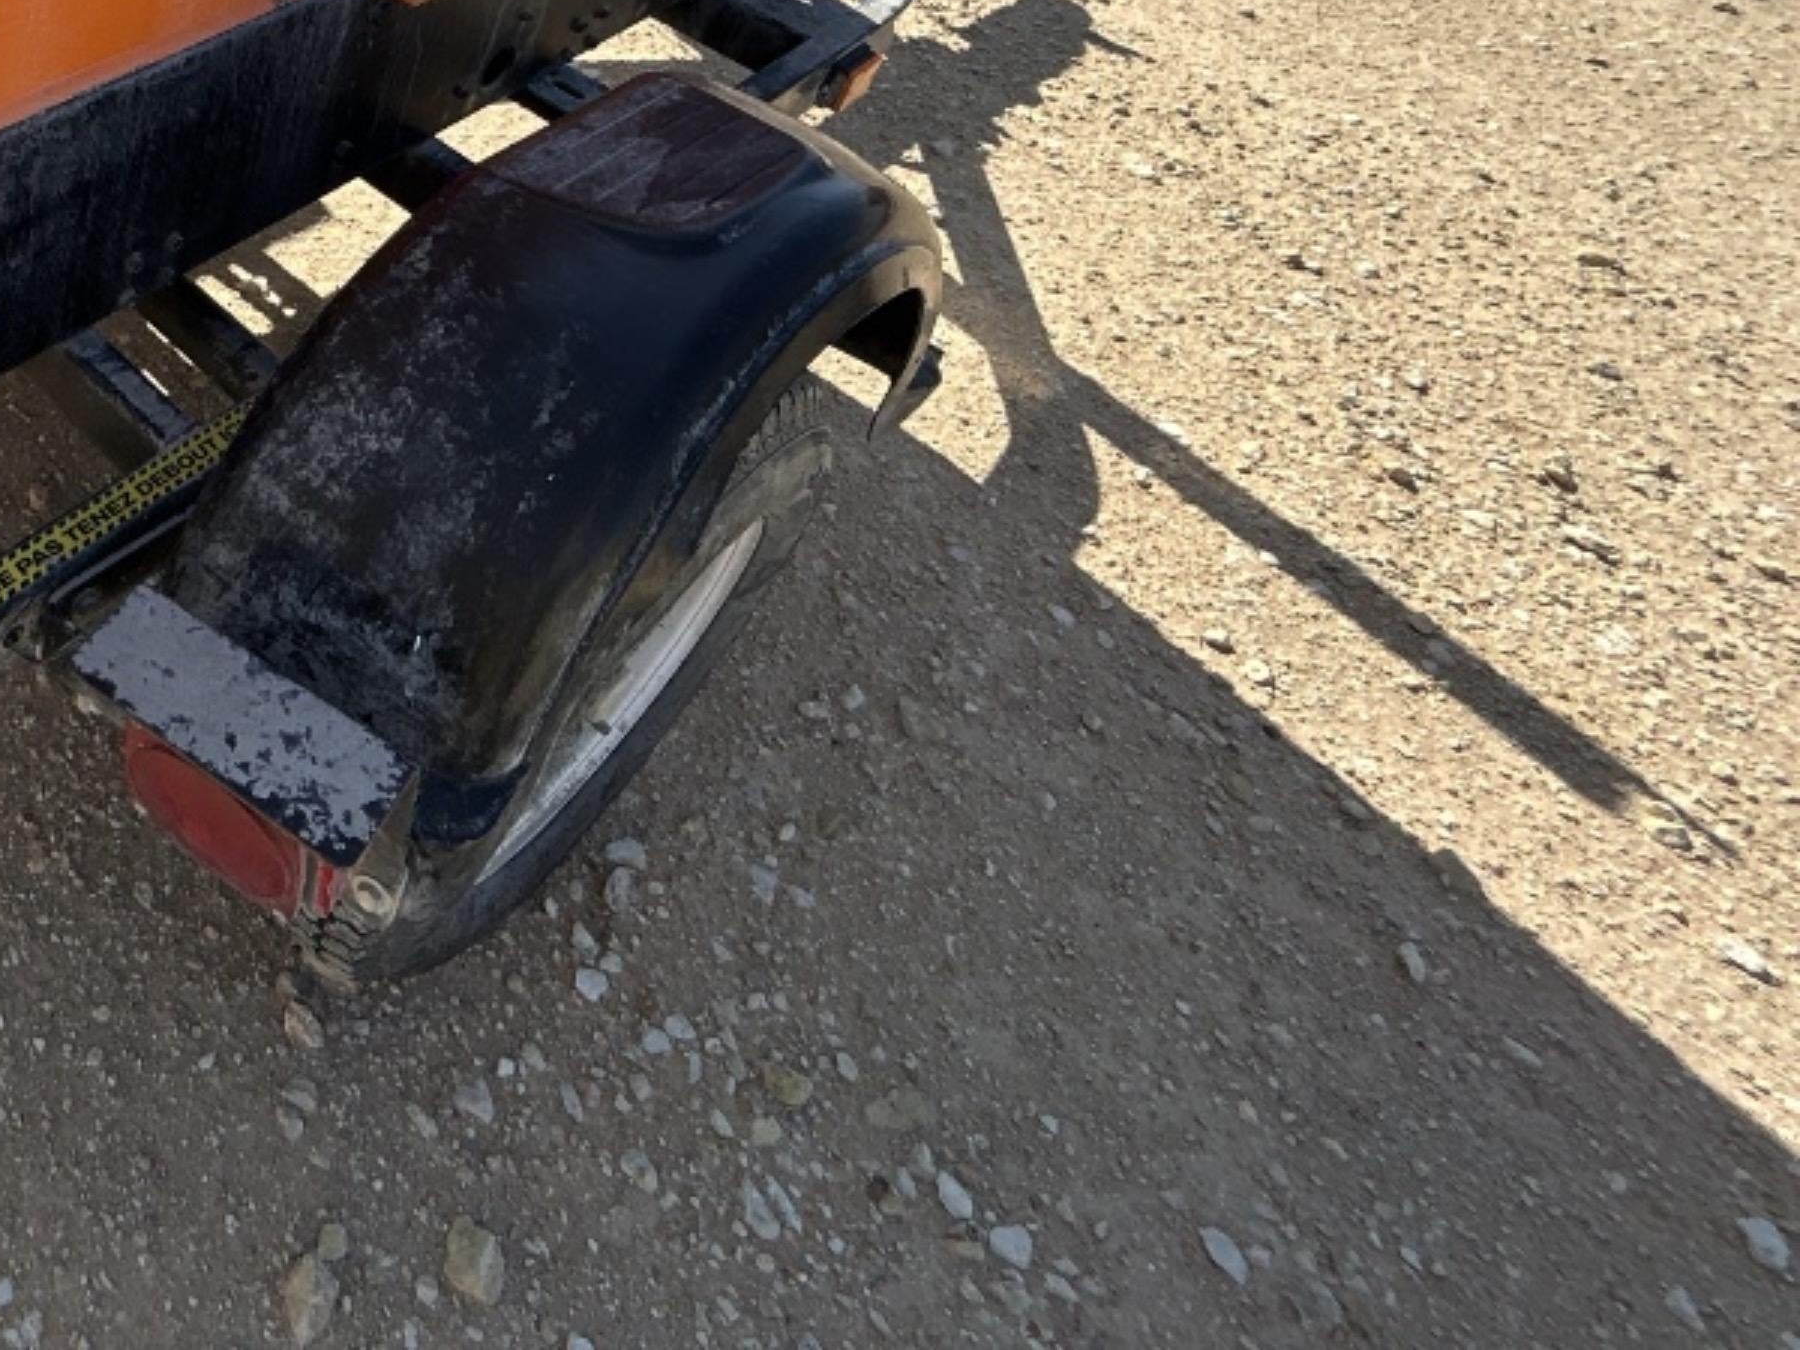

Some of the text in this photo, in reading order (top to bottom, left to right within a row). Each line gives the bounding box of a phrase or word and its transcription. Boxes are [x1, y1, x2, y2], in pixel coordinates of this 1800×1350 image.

[14, 537, 65, 574] PAS
[63, 492, 133, 542] TENEZ
[134, 435, 218, 498] DEBOUT
